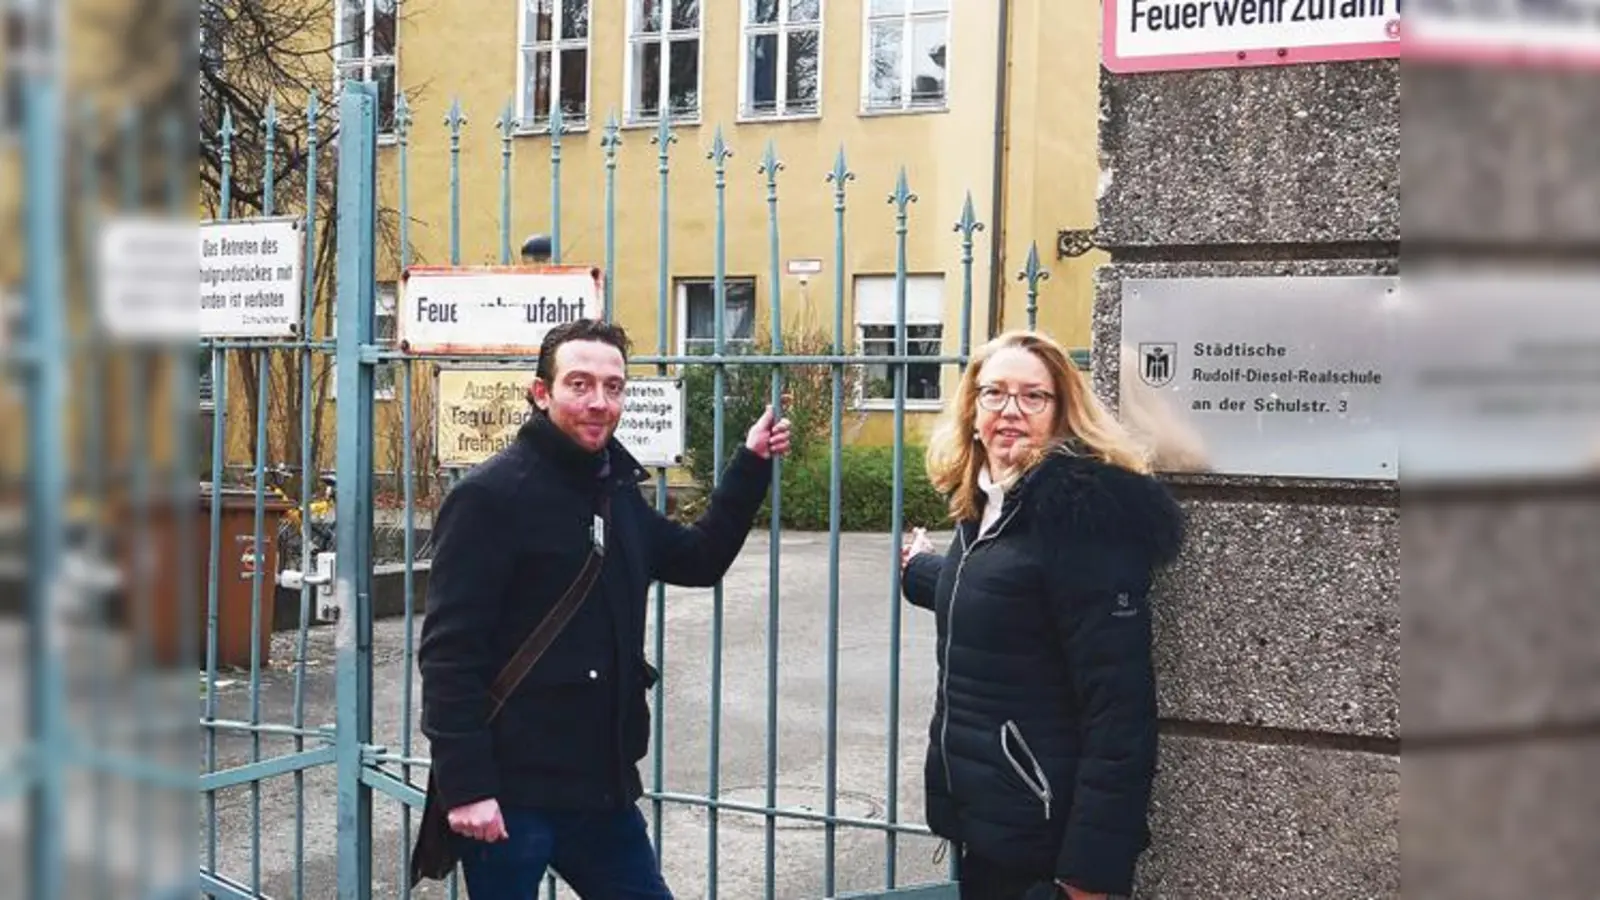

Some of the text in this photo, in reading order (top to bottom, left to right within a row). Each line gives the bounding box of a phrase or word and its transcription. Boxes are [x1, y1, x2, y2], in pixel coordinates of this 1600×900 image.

[221, 237, 258, 256] Betreten
[261, 236, 278, 255] des
[201, 290, 284, 309] unden ist verboten
[417, 296, 585, 323] Feueufahrt
[1193, 342, 1287, 357] Städtische
[1192, 368, 1382, 385] Rudolf-Diesel-Realschule
[625, 386, 665, 397] etreten
[624, 400, 672, 416] ulanlage
[1191, 398, 1348, 413] an der Schulstr. 3
[451, 404, 479, 428] Tag
